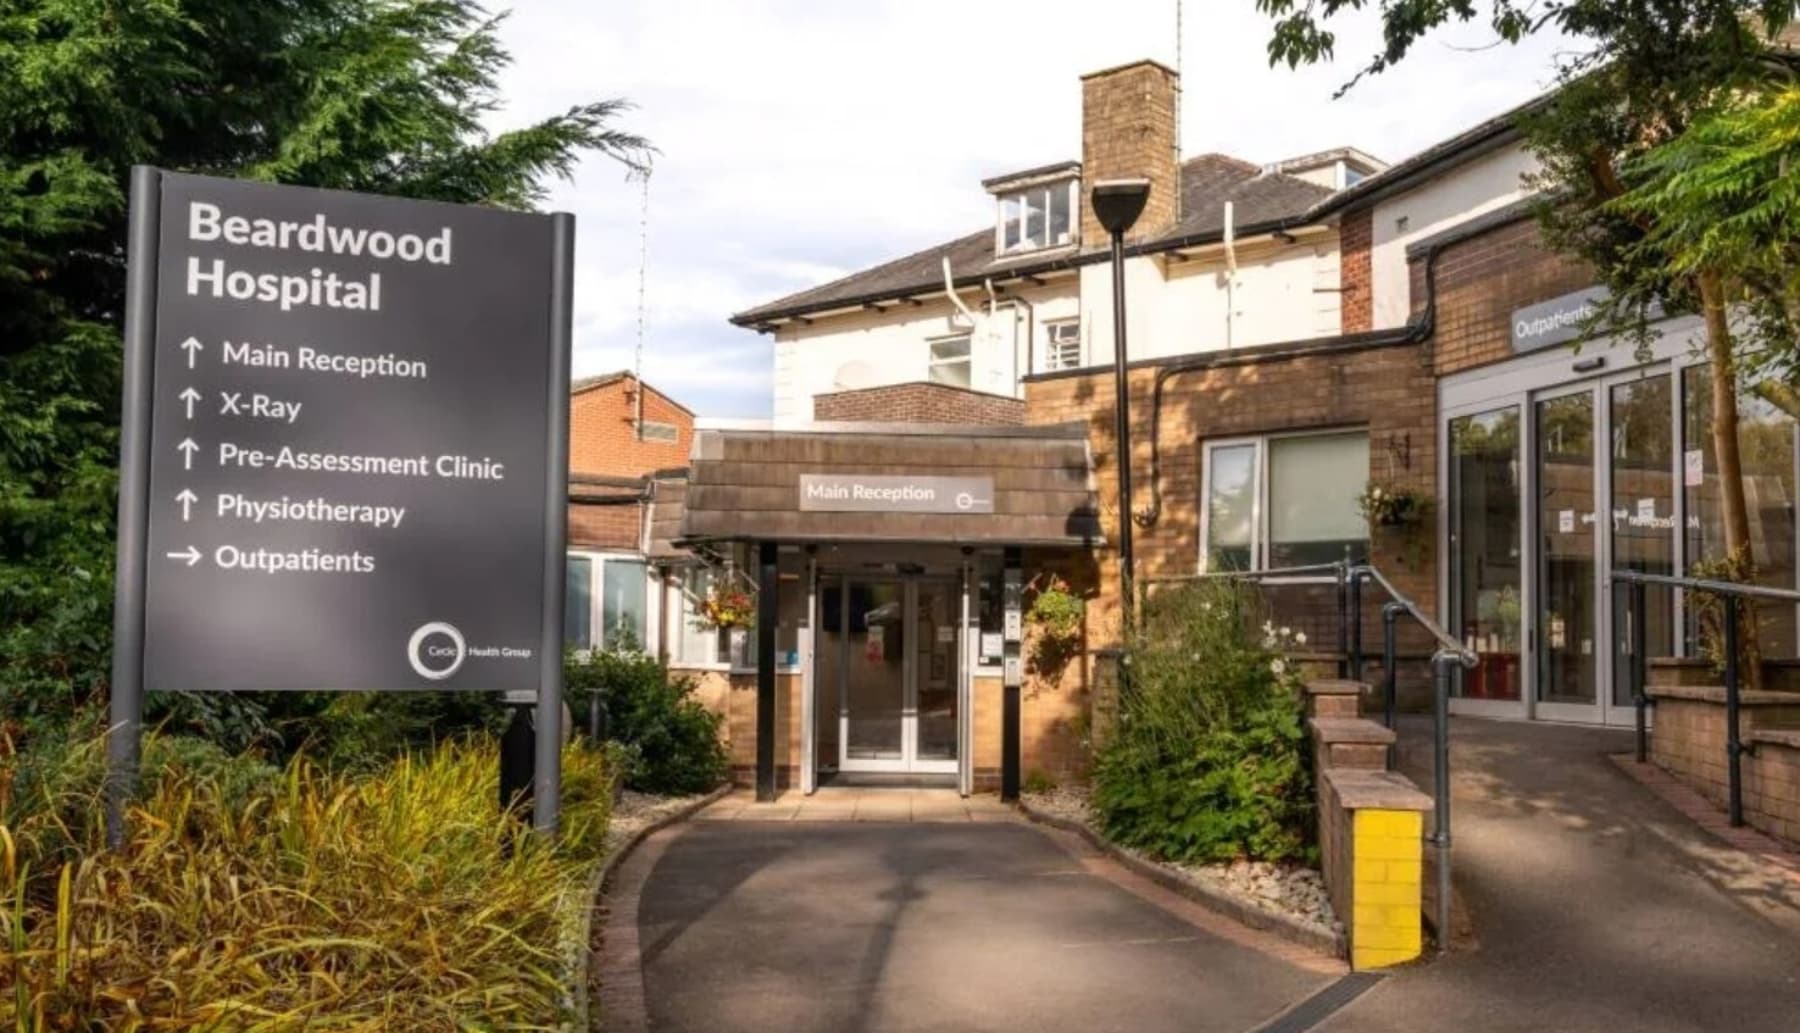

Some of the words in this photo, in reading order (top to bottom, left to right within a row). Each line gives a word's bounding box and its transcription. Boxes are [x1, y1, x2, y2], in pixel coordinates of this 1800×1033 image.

[188, 201, 453, 265] Beardwood
[186, 256, 381, 311] Hospital
[1515, 304, 1592, 339] Outpatients
[223, 341, 289, 368] Main
[298, 347, 427, 378] Reception
[220, 392, 302, 423] X-Ray
[219, 443, 428, 477] Pre-Assessment
[436, 456, 504, 480] Clinic
[807, 484, 849, 499] Main
[853, 484, 935, 502] Reception
[217, 494, 405, 527] Physiotherapy
[215, 545, 375, 574] Outpatients
[468, 647, 500, 657] Health
[501, 647, 531, 658] Group
